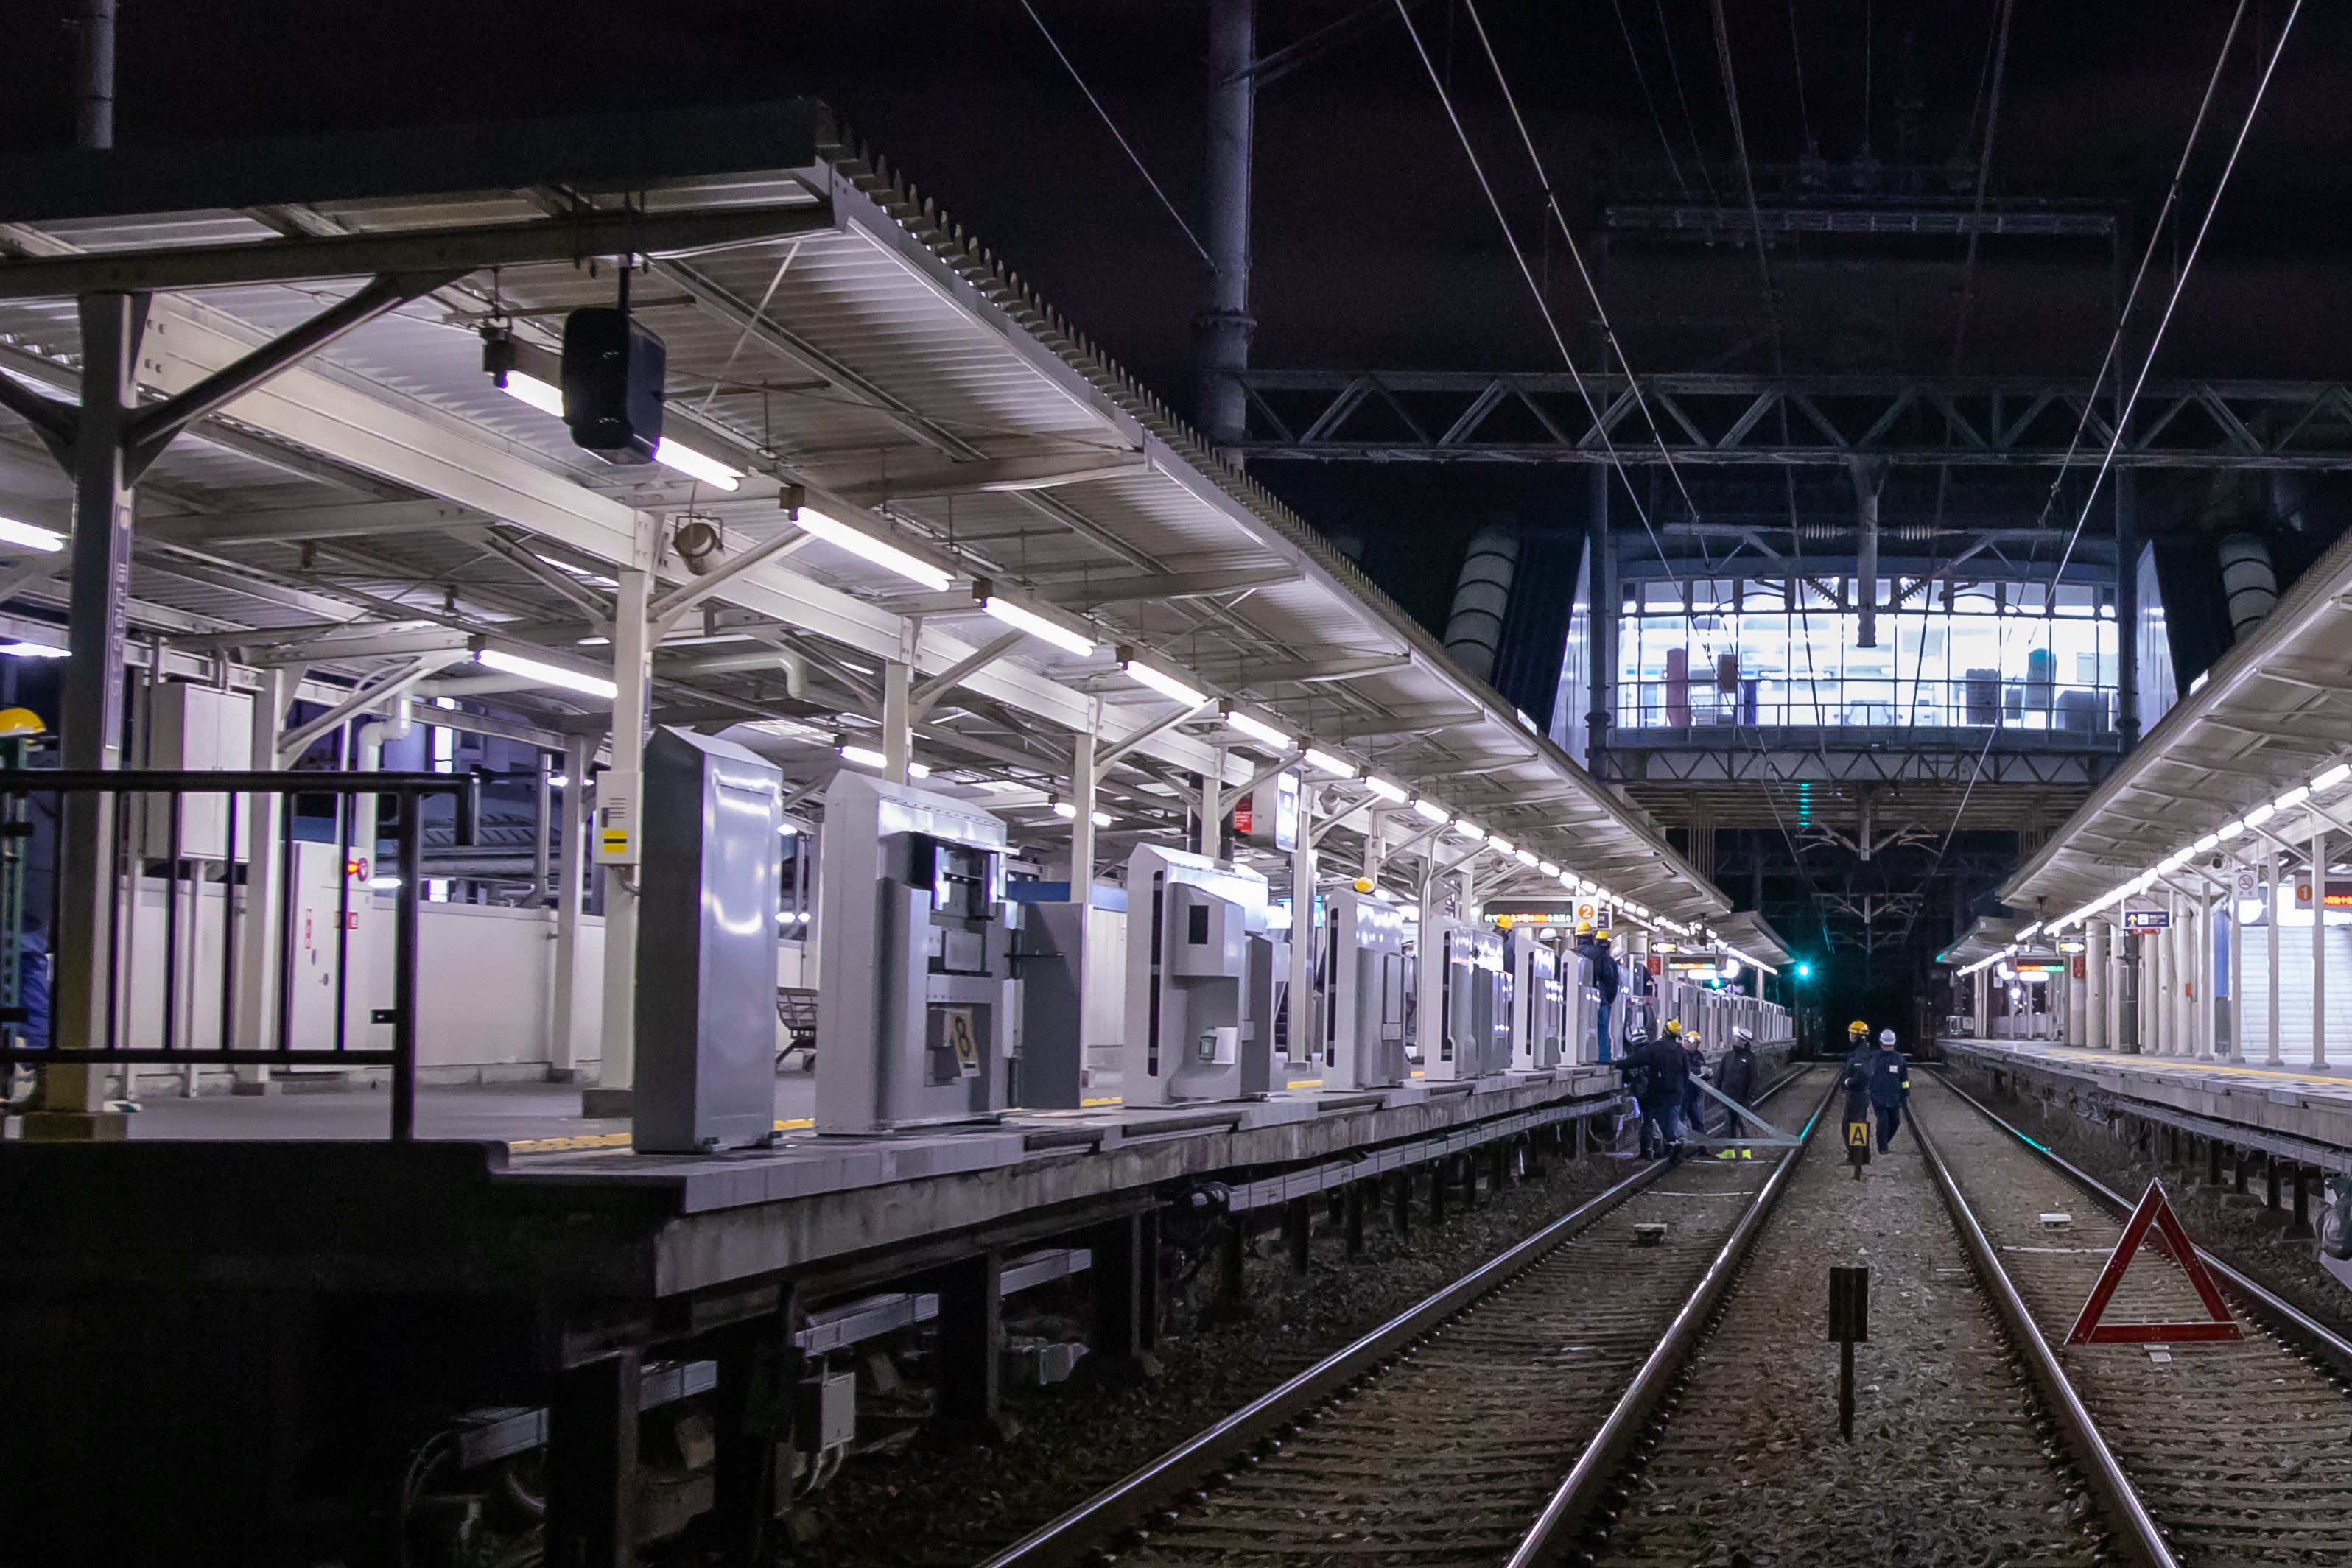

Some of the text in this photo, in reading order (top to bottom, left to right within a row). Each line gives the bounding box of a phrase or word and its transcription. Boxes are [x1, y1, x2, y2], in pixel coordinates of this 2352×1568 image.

[2301, 886, 2309, 899] 1
[1582, 906, 1592, 918] 2
[955, 1016, 971, 1057] 8
[1850, 1125, 1865, 1145] A
